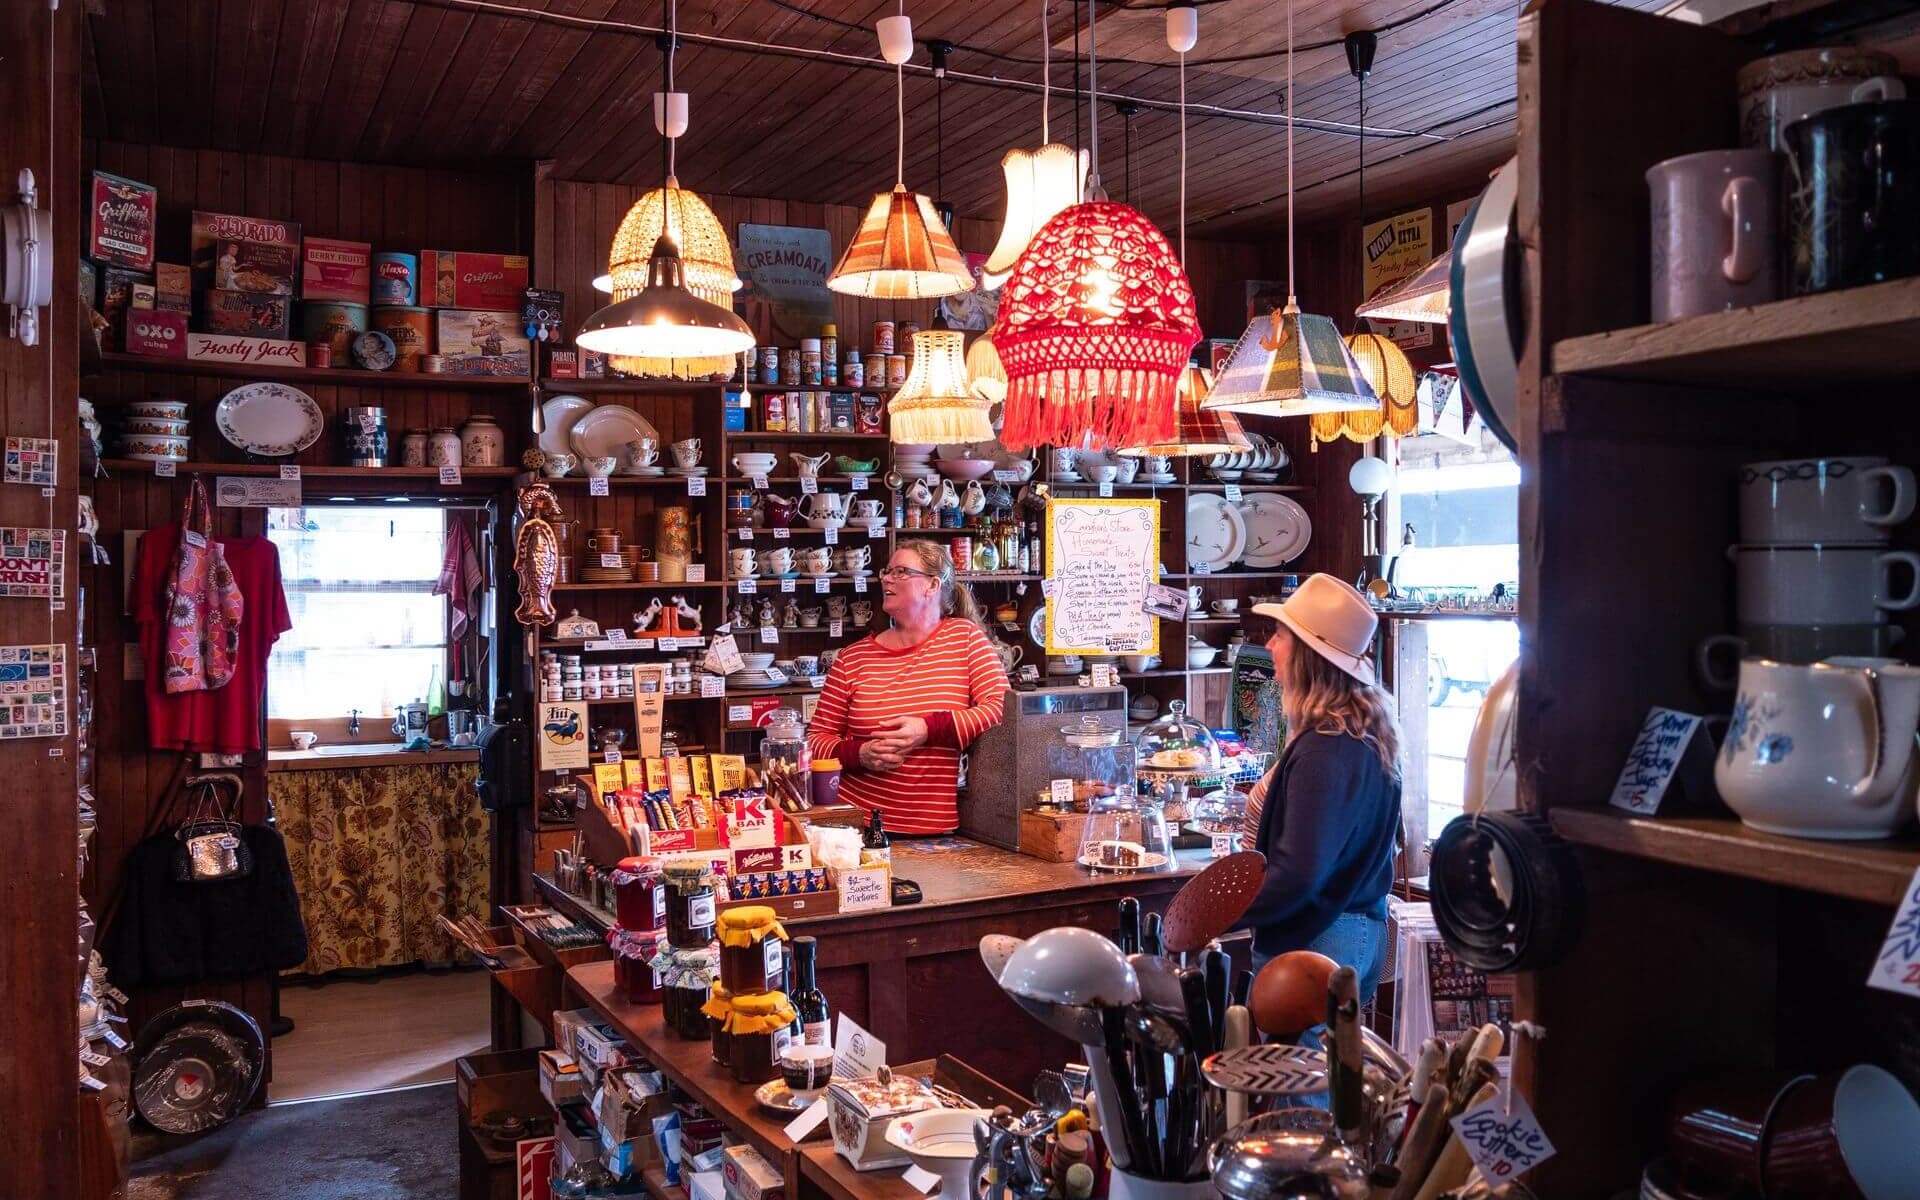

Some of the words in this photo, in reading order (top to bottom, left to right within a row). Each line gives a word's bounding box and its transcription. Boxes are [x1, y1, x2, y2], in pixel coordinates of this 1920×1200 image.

[103, 227, 143, 242] BISCUITS
[310, 250, 336, 260] BERRY
[747, 250, 827, 277] CREAMOATA
[379, 263, 409, 280] Glaxo
[136, 324, 177, 340] OXO
[143, 341, 168, 350] cubes
[195, 339, 253, 361] Frosty
[254, 341, 304, 362] Jack
[547, 706, 569, 720] Tui
[1050, 700, 1063, 714] 20
[735, 799, 766, 820] K
[736, 819, 766, 828] BAR
[789, 849, 803, 861] K
[847, 892, 879, 904] Mixtures
